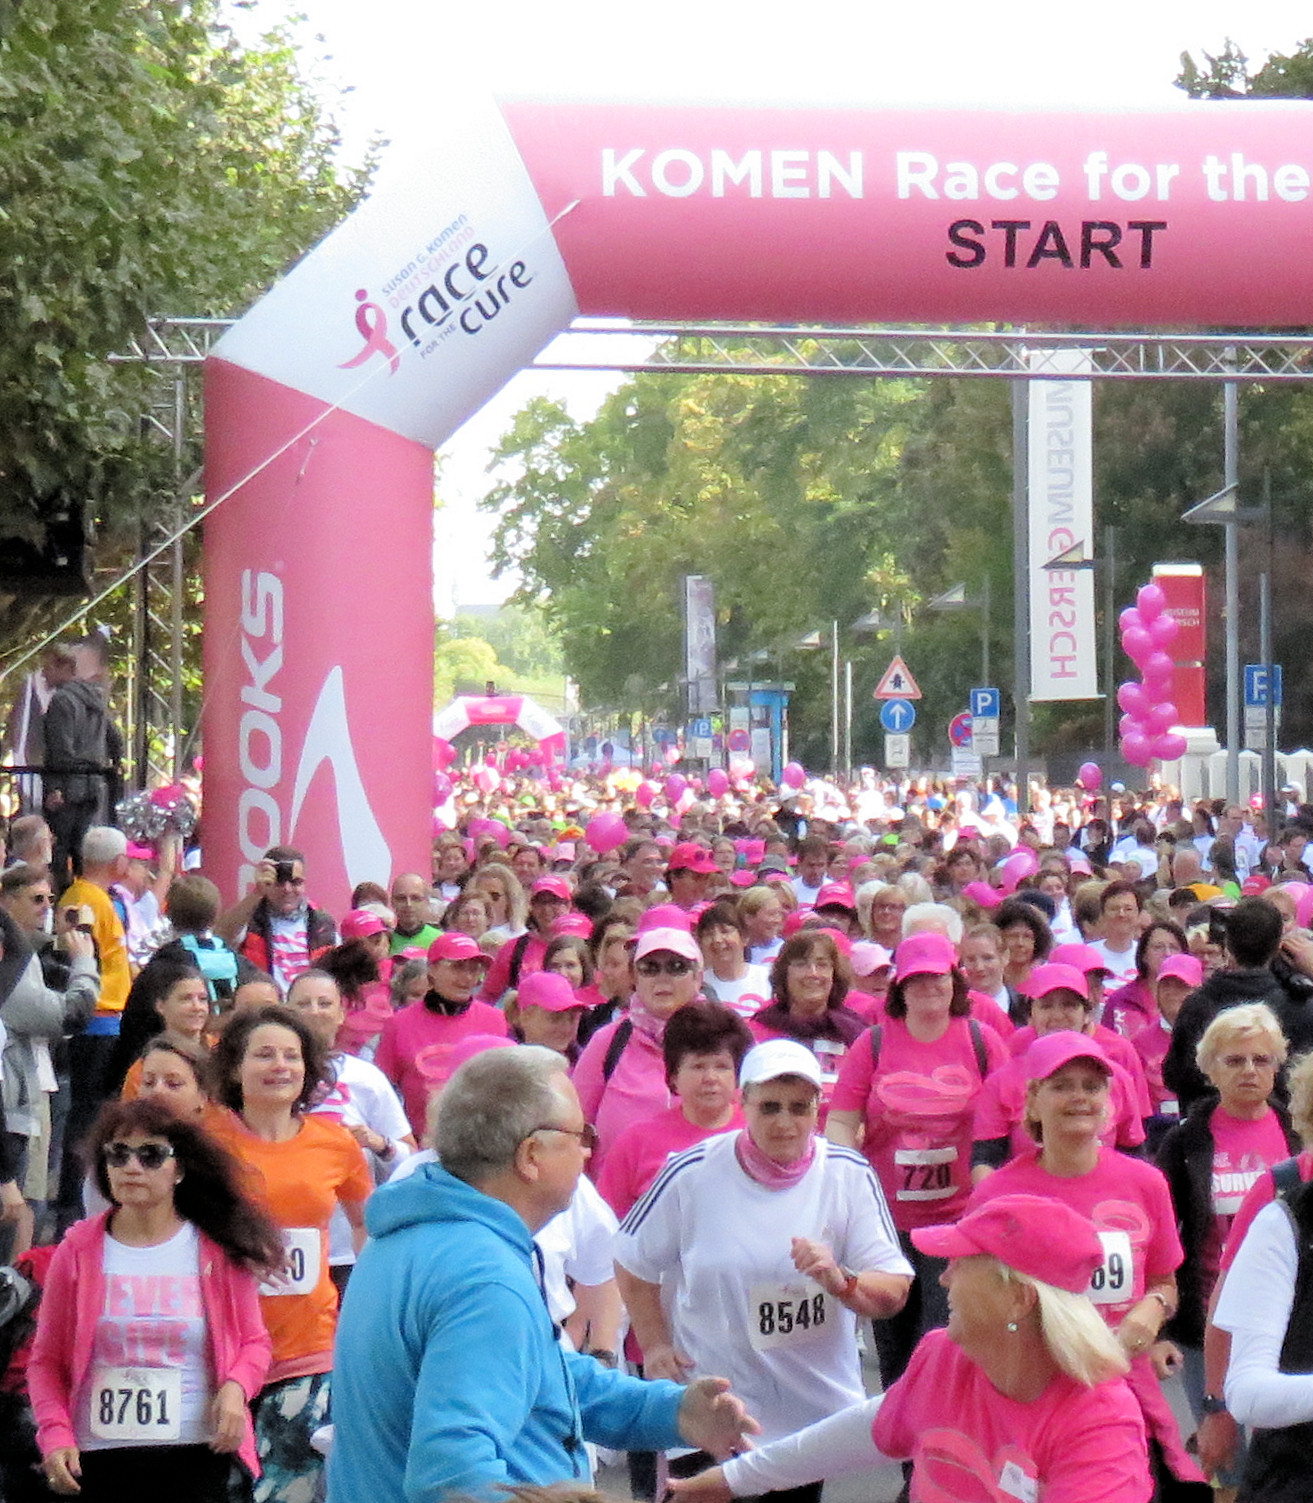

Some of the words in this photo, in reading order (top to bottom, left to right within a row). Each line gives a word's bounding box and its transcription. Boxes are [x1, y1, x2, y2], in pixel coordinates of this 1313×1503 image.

[602, 148, 864, 199] KOMEN
[896, 151, 1060, 200] Race
[1084, 151, 1180, 201] for
[1202, 152, 1311, 202] the
[945, 218, 1168, 270] START
[401, 243, 499, 347] race
[460, 260, 533, 335] cure
[976, 693, 993, 715] P
[903, 1162, 951, 1190] 720
[759, 1293, 825, 1335] 8548
[100, 1388, 170, 1425] 8761
